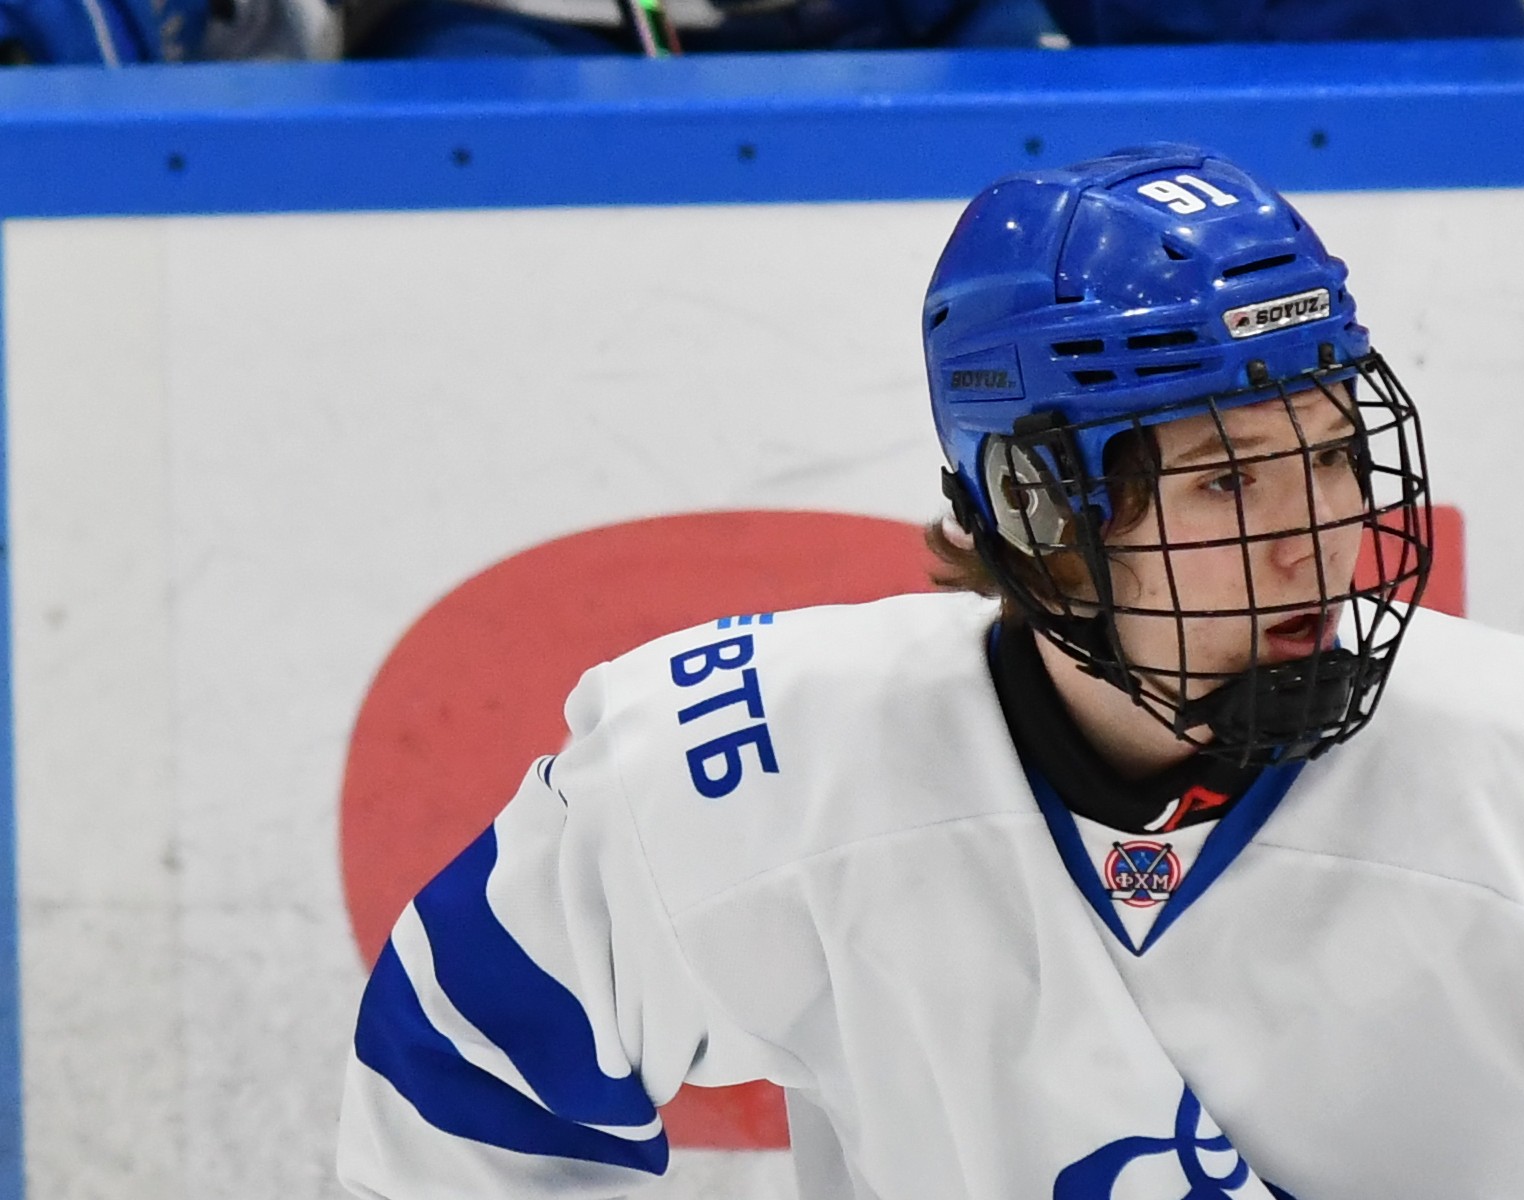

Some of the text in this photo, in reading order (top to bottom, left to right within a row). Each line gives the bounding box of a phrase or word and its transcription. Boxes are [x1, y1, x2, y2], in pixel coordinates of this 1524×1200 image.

[1137, 174, 1240, 215] 91
[1256, 296, 1320, 325] SOYUZ
[669, 633, 781, 799] ВТБ
[1115, 872, 1170, 890] ФХМ
